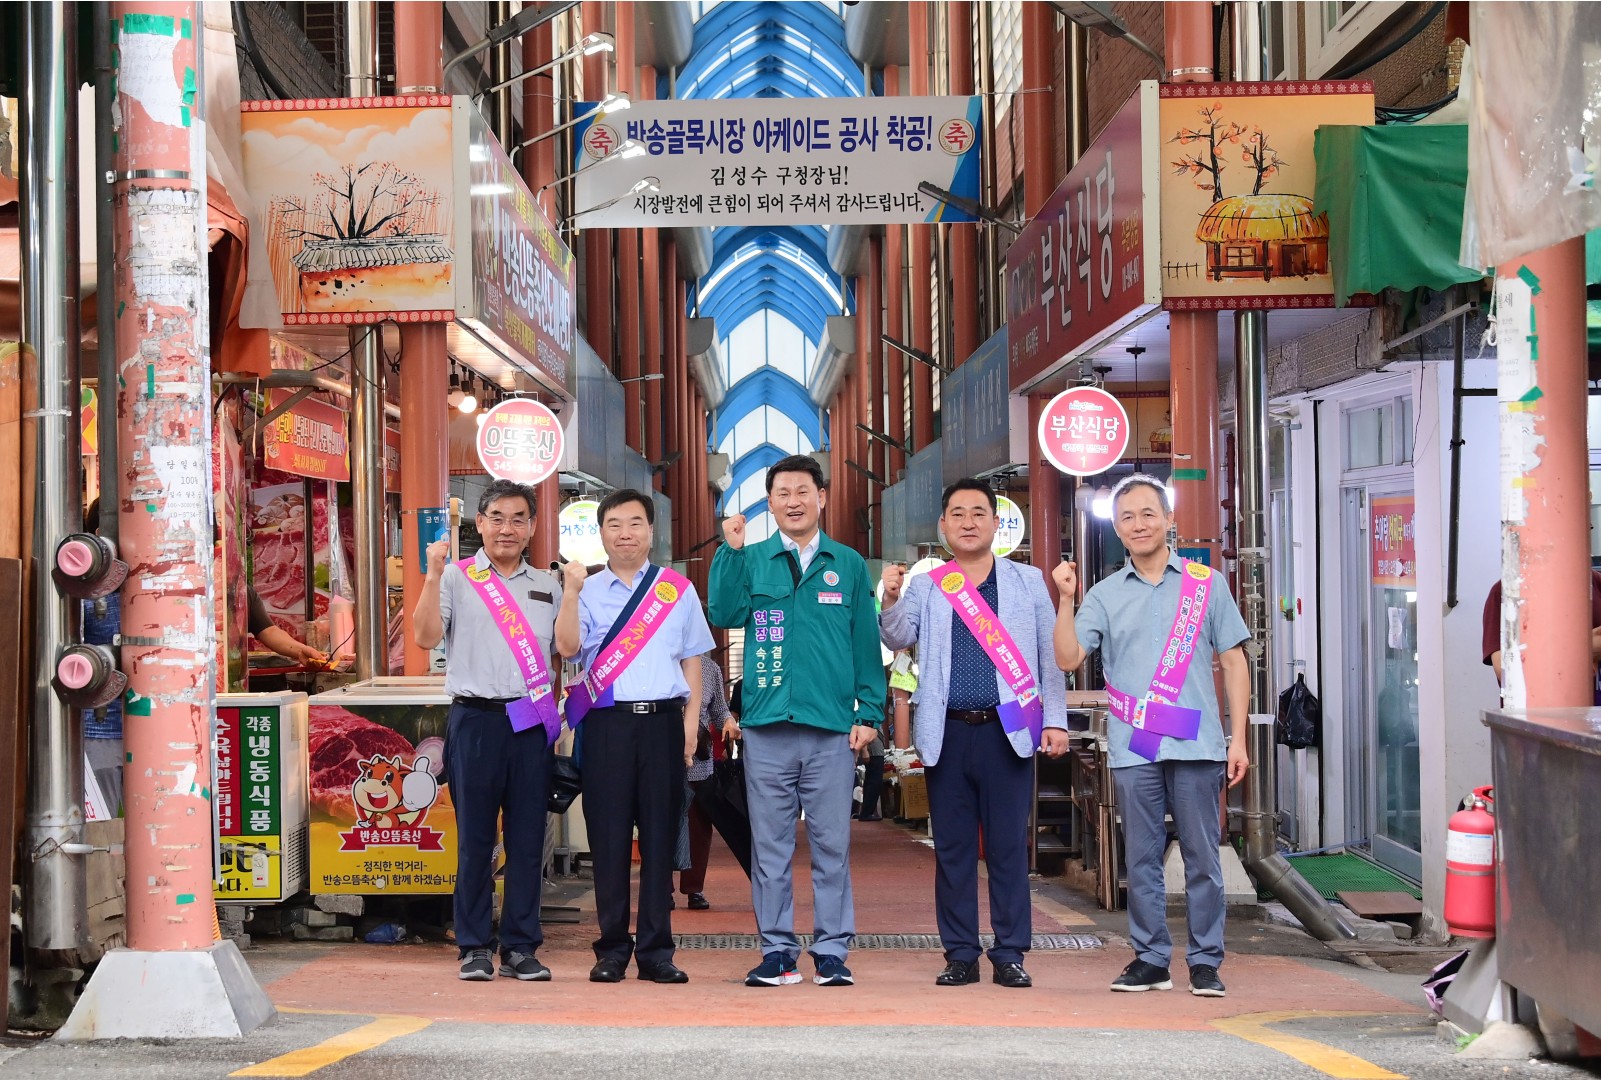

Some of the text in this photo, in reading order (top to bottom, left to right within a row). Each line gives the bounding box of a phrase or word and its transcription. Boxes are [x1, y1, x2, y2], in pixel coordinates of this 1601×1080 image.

[589, 128, 614, 153] 축
[627, 115, 932, 156] 반송골목시장 아케이드 공사 착공!
[944, 122, 969, 150] 축
[776, 165, 849, 186] 구청장님!
[633, 192, 925, 215] 시장발전에 큰힘이 되어 주셔서 감사드립니다.
[1041, 151, 1115, 343] 부산식당
[1050, 415, 1120, 441] 부산식당
[484, 427, 555, 461] 으뜸축산
[425, 515, 446, 524] 금연시
[560, 523, 598, 537] 거창상
[1175, 596, 1192, 636] 전통시장
[1190, 585, 1206, 623] 시장에서
[483, 582, 540, 674] 행복한 추석 보내세요
[596, 601, 663, 681] 행복한 추석 보내세요
[957, 590, 1024, 679] 행복한 추석 보내세요
[753, 610, 768, 688] 현장 속으로
[769, 610, 784, 687] 구민 곁으로
[246, 716, 272, 732] 각종
[248, 735, 272, 832] 냉동식품
[360, 829, 422, 843] 반송으뜸축산
[363, 861, 393, 871] 정직한
[392, 875, 411, 885] 함께
